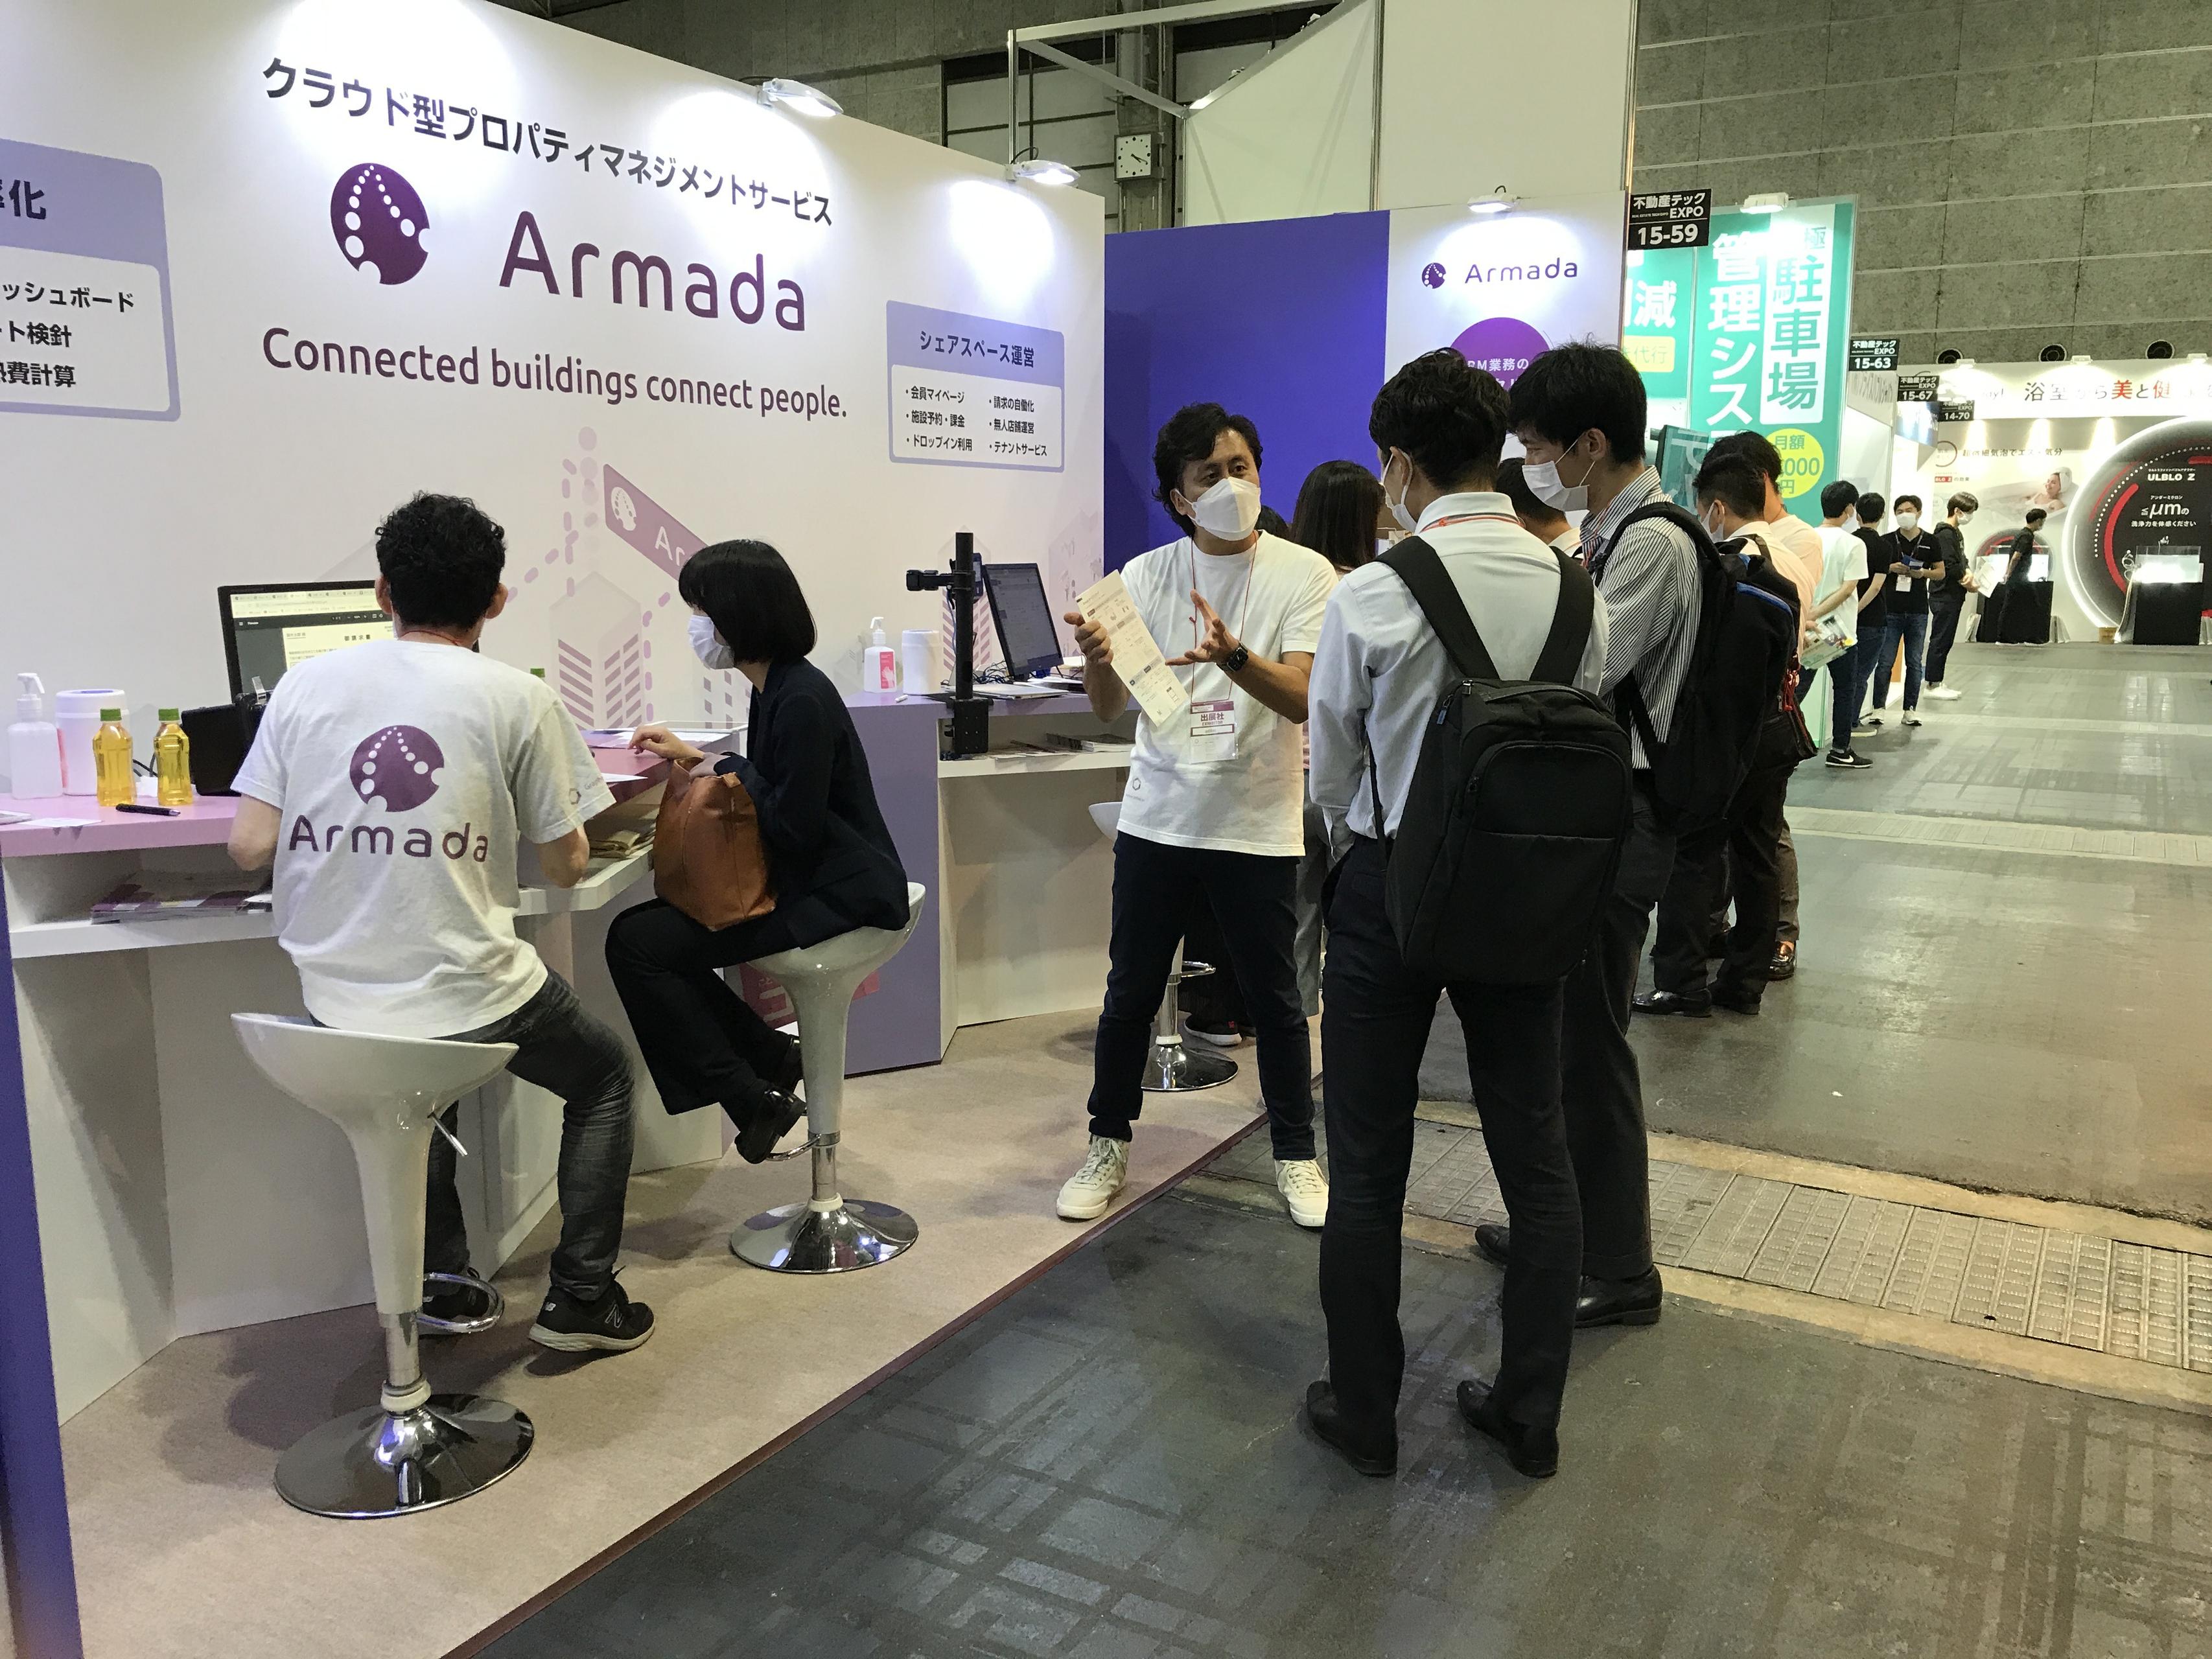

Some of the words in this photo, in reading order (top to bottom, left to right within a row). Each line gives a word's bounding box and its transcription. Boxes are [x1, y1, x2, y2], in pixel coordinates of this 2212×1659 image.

[262, 57, 833, 226] クラウド型プロパティマネジメントサービス
[1633, 192, 1706, 209] 不動産テック
[1670, 205, 1704, 219] EXPO
[1638, 223, 1698, 246] 15-59
[500, 211, 806, 332] Armada
[1464, 257, 1578, 284] Armada
[0, 320, 72, 348] ト検針
[1706, 230, 1762, 447] 管理シス
[1767, 254, 1824, 411] 駐車場
[919, 331, 1034, 368] シェアスペース運営
[1623, 345, 1668, 365] 代行
[1852, 340, 1896, 349] 不動産テック
[1854, 357, 1891, 369] 15-63
[262, 327, 479, 386] Connected
[491, 349, 638, 405] buildings
[646, 370, 752, 409] connect
[760, 384, 847, 422] people.
[1902, 391, 1933, 400] 15-67
[1944, 412, 1970, 421] 14-70
[1775, 434, 1806, 450] 月額
[1780, 479, 1795, 494] 円
[1200, 712, 1224, 722] 出展社
[288, 815, 489, 864] Armada
